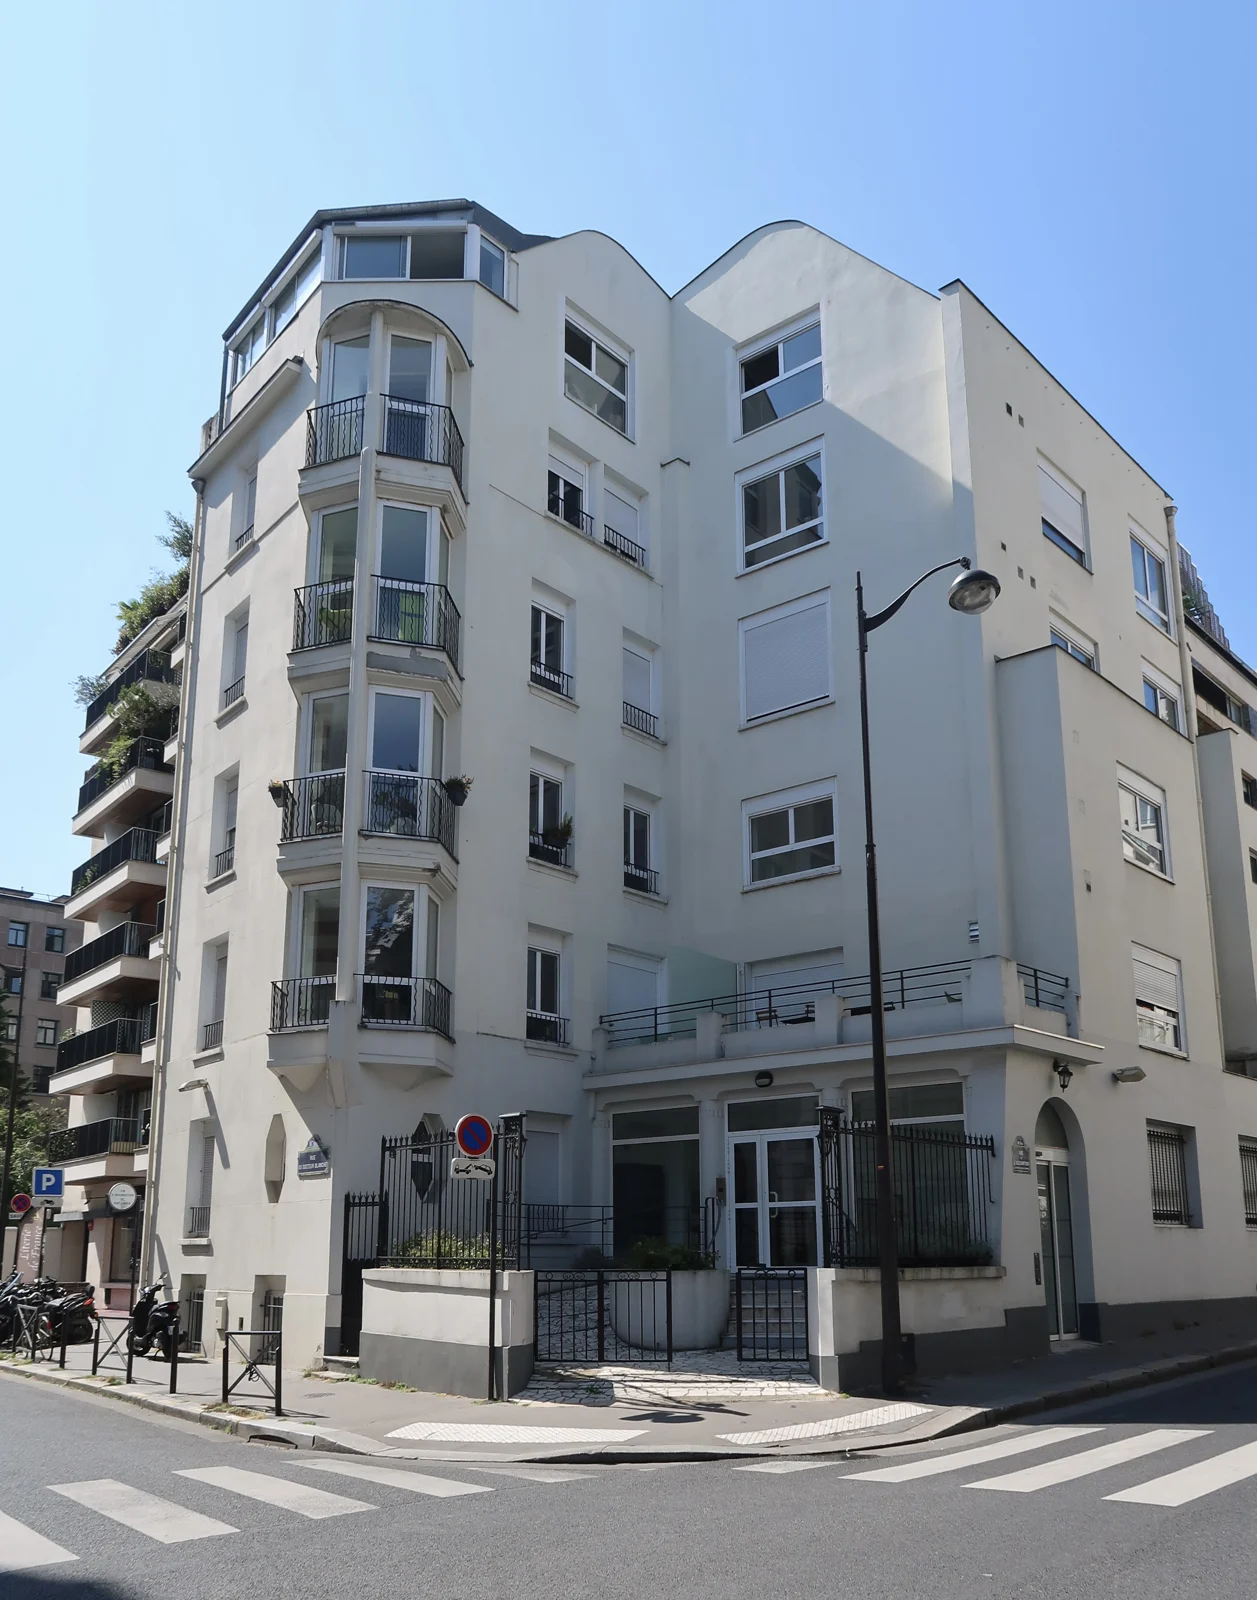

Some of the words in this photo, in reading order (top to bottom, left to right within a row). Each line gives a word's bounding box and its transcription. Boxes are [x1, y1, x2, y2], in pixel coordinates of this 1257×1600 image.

[41, 1173, 56, 1191] P
[20, 1229, 32, 1260] Literie
[31, 1226, 44, 1257] France
[27, 1260, 40, 1271] de
